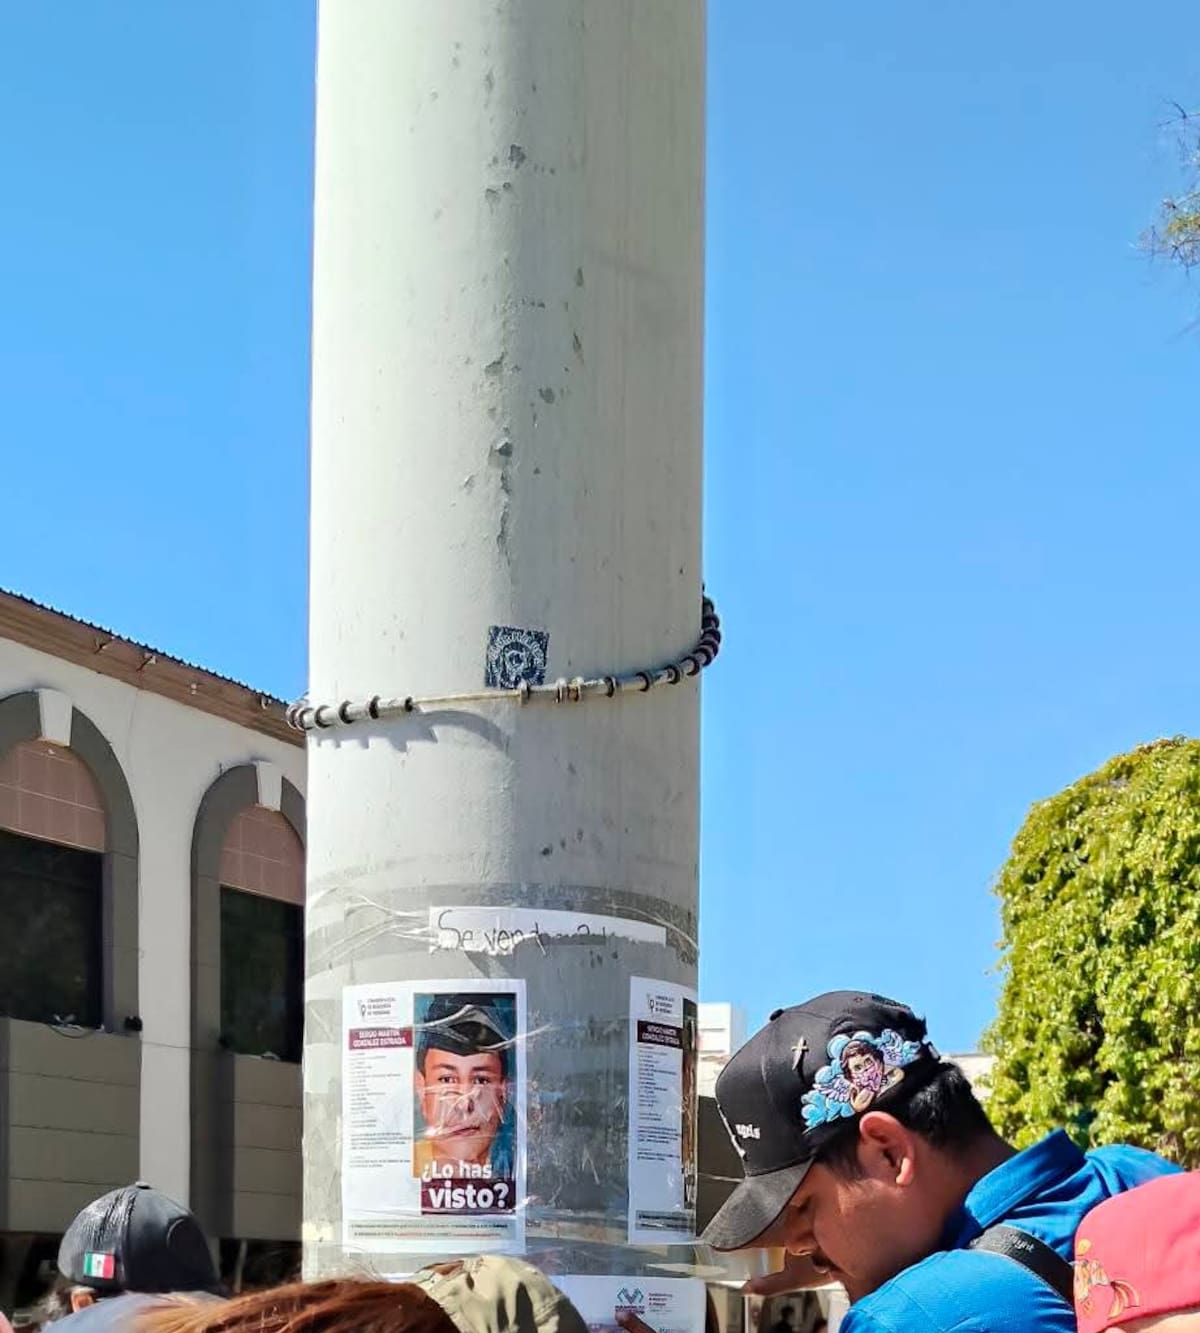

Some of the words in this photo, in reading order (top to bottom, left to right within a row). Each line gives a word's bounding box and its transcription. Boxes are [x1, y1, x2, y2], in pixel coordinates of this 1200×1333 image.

[438, 908, 474, 948] Se
[422, 1160, 453, 1182] ¿Lo
[459, 1160, 492, 1179] has
[428, 1180, 510, 1209] visto?
